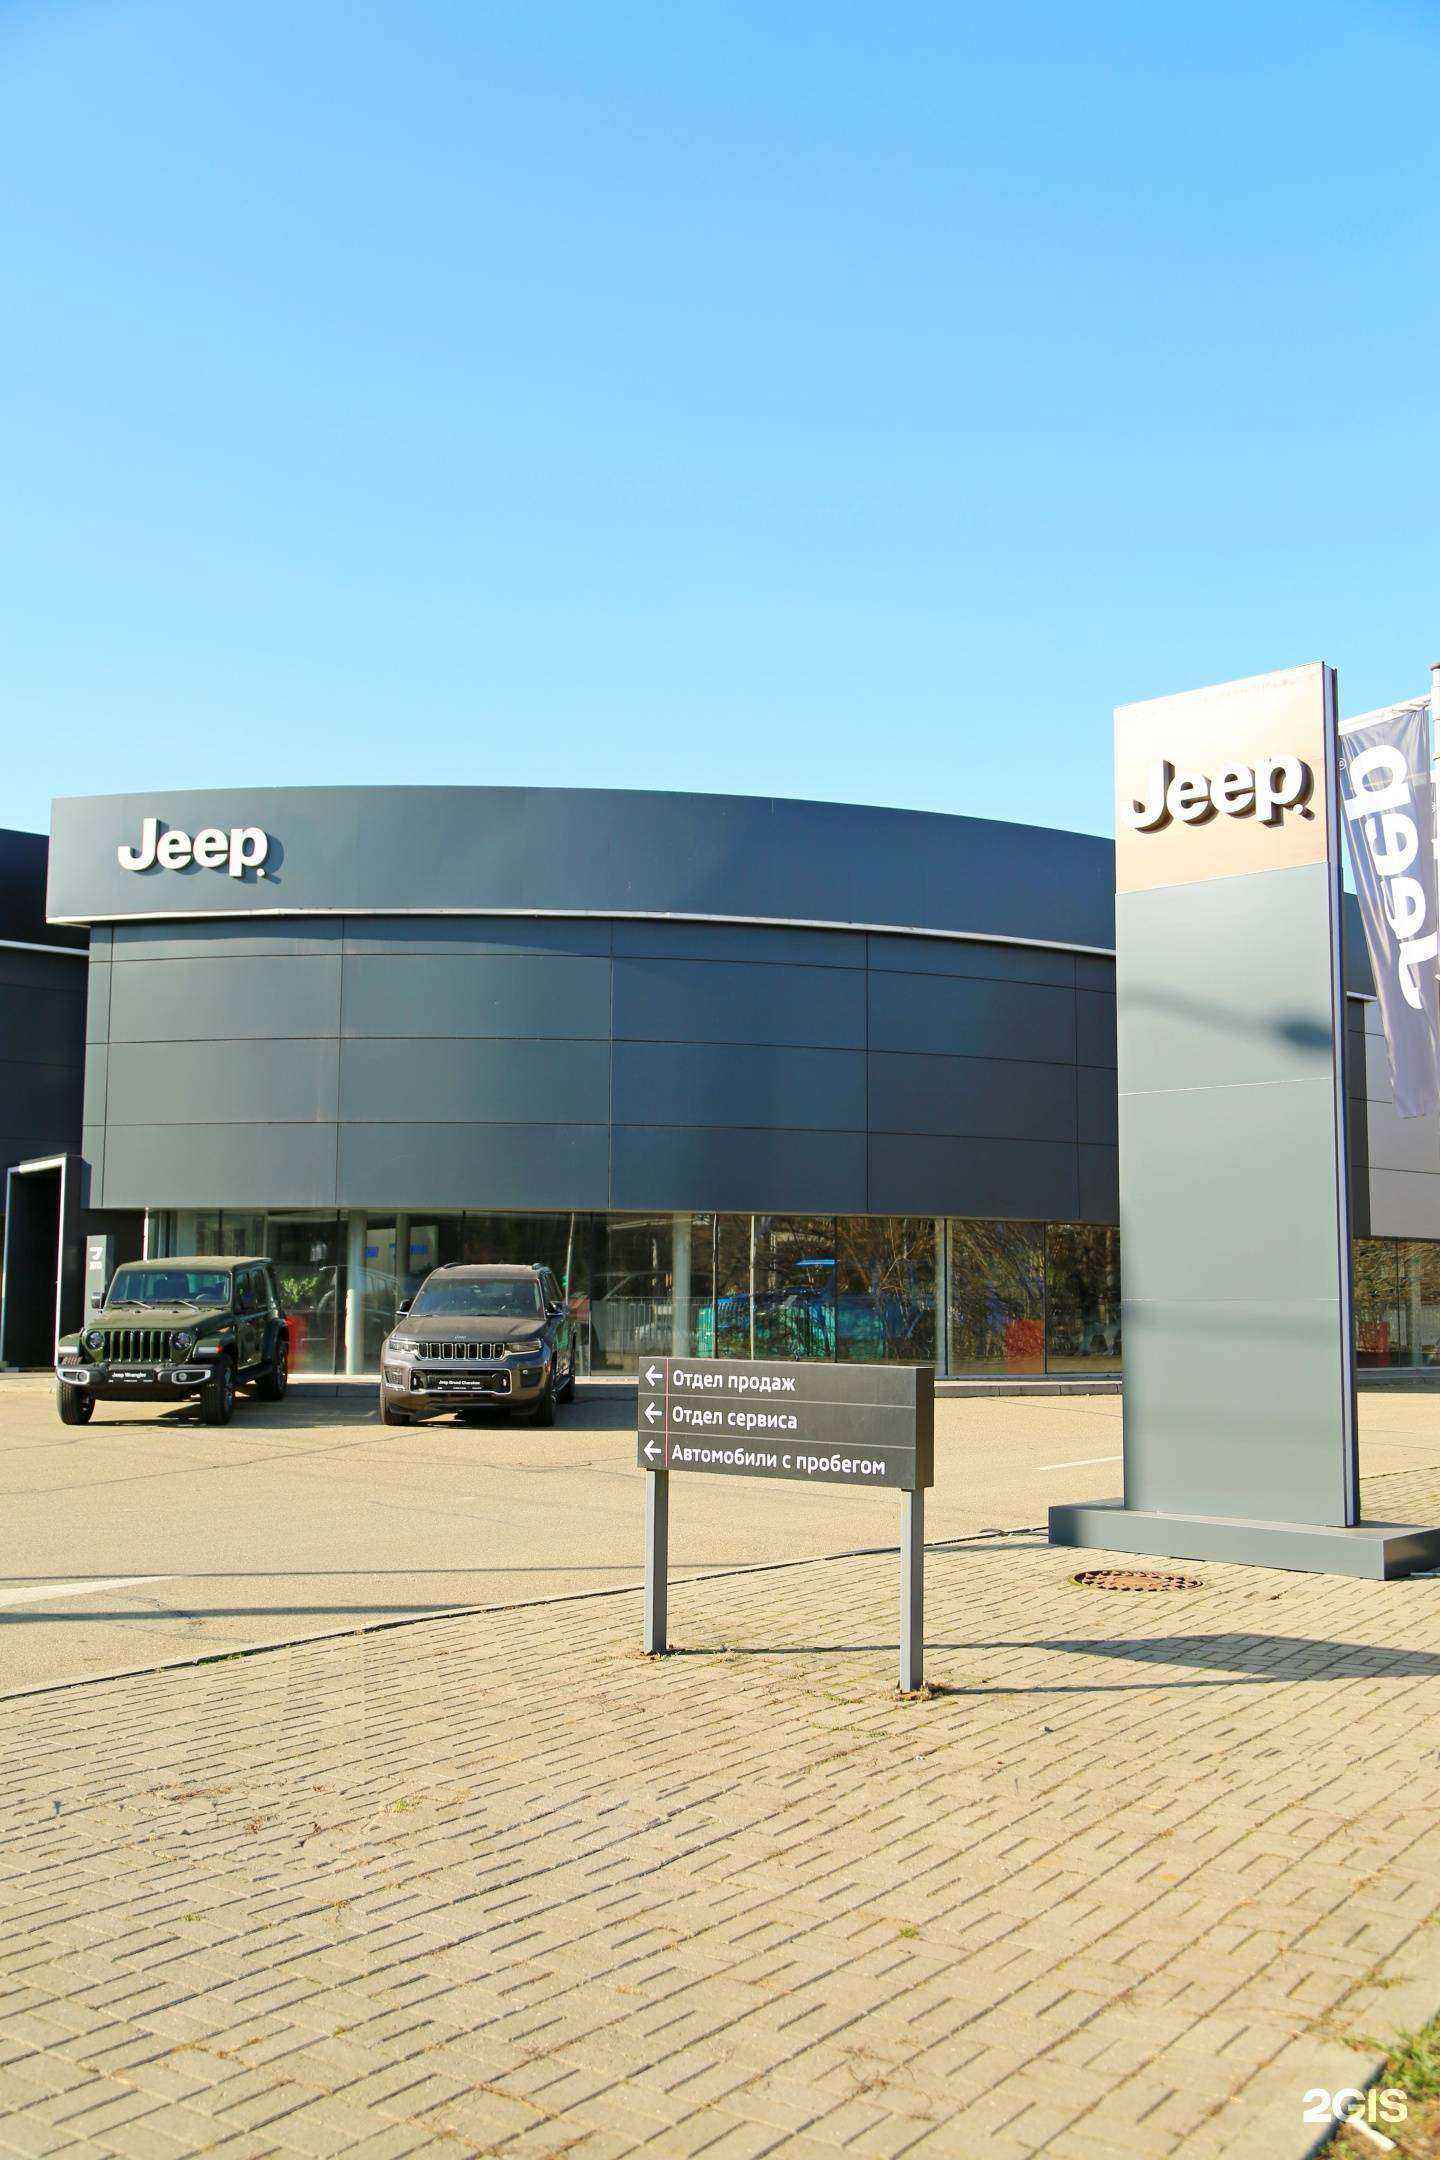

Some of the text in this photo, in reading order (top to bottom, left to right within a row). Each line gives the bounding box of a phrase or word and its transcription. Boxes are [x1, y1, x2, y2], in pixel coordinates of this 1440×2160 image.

[672, 1369, 796, 1393] Отдел продаж
[672, 1405, 798, 1431] Отдел сервиса
[671, 1444, 886, 1476] Автомобили с пробегом
